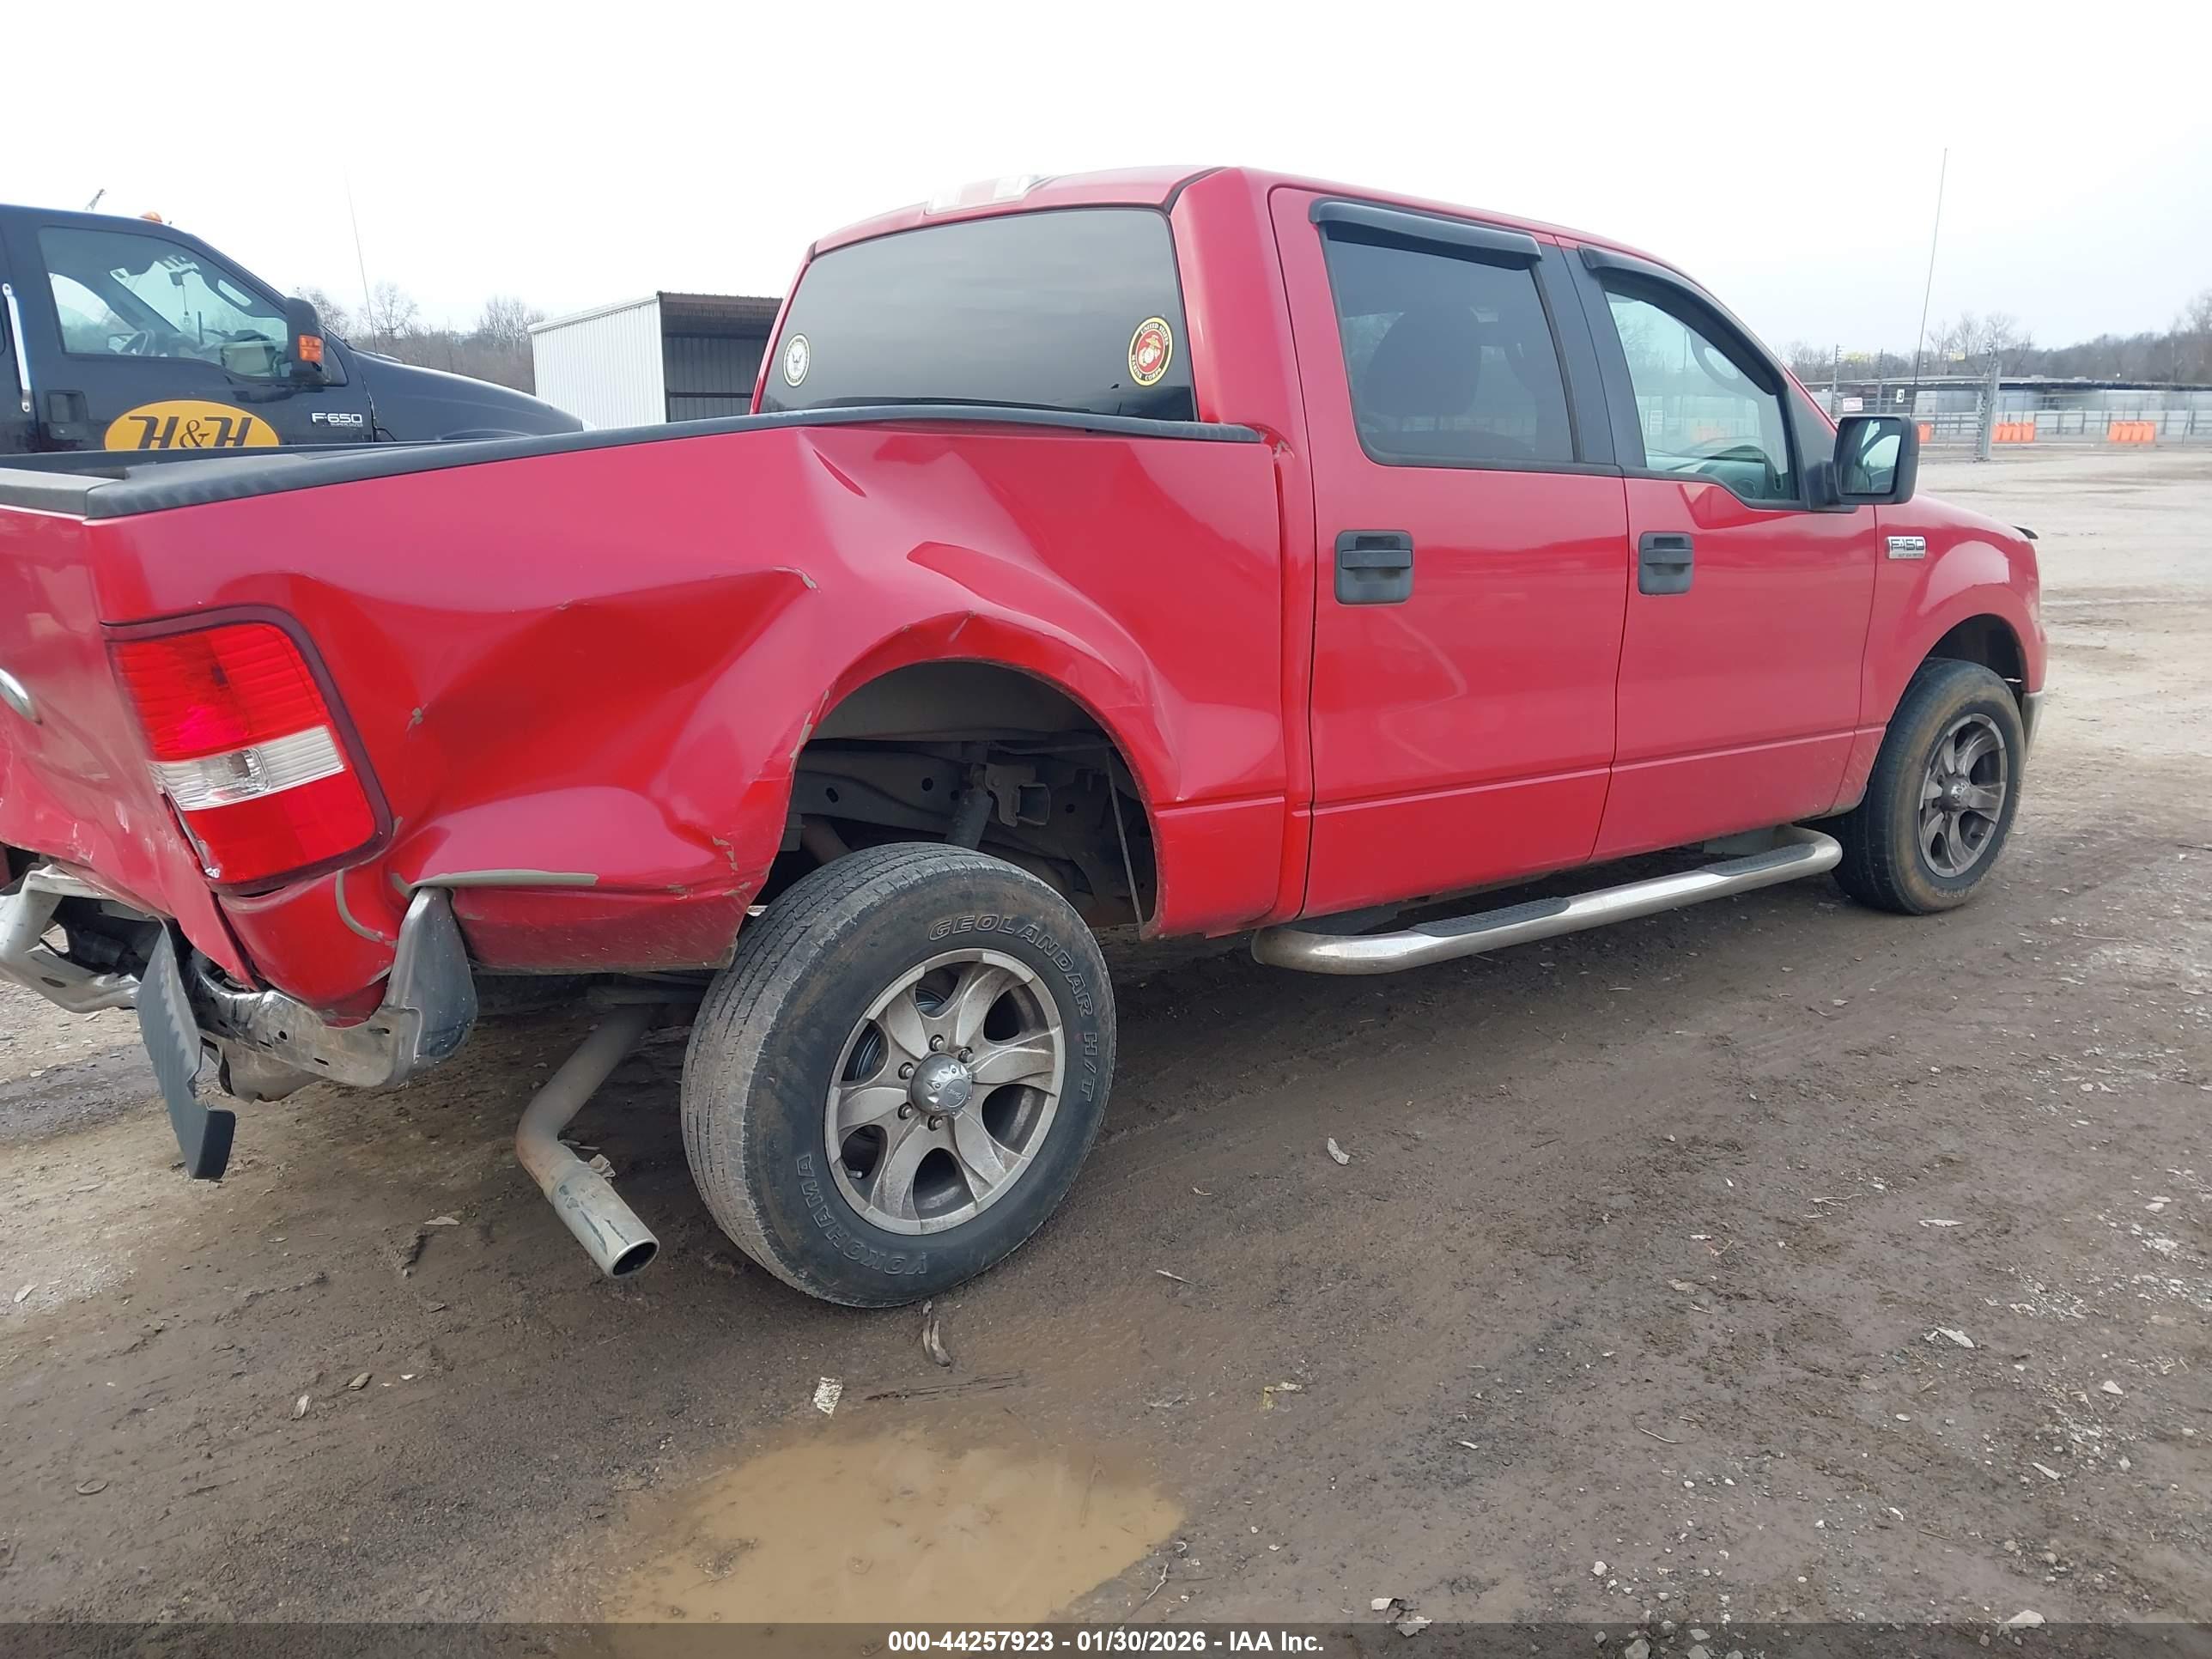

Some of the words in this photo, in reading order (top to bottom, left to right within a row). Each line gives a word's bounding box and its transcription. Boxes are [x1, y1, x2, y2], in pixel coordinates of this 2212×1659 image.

[129, 416, 253, 448] H&H
[928, 915, 1093, 1018] GEOLANDAR
[1079, 1031, 1098, 1103] H/T
[797, 1154, 928, 1275] YOKOHAMA
